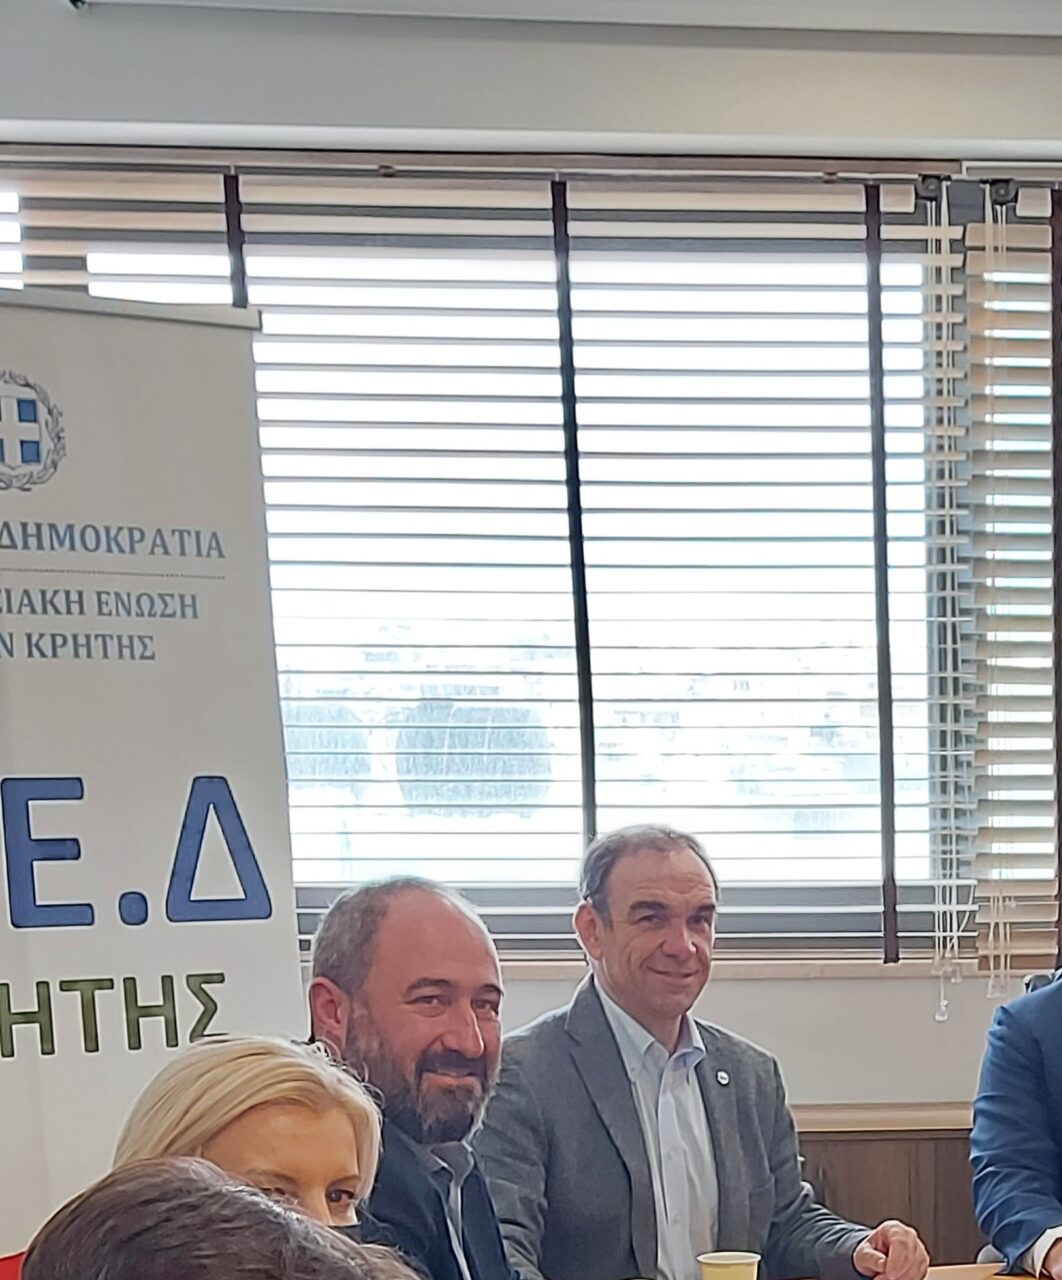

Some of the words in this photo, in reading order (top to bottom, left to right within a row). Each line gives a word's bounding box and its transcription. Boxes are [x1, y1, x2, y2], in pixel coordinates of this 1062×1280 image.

[0, 520, 226, 559] ΔΗΜΟΚΡΑΤΙΑ
[0, 587, 86, 616] ΙΑΚΗ
[95, 589, 199, 620] ΕΝΩΣΗ
[24, 631, 156, 661] ΚΡΗΤΗΣ
